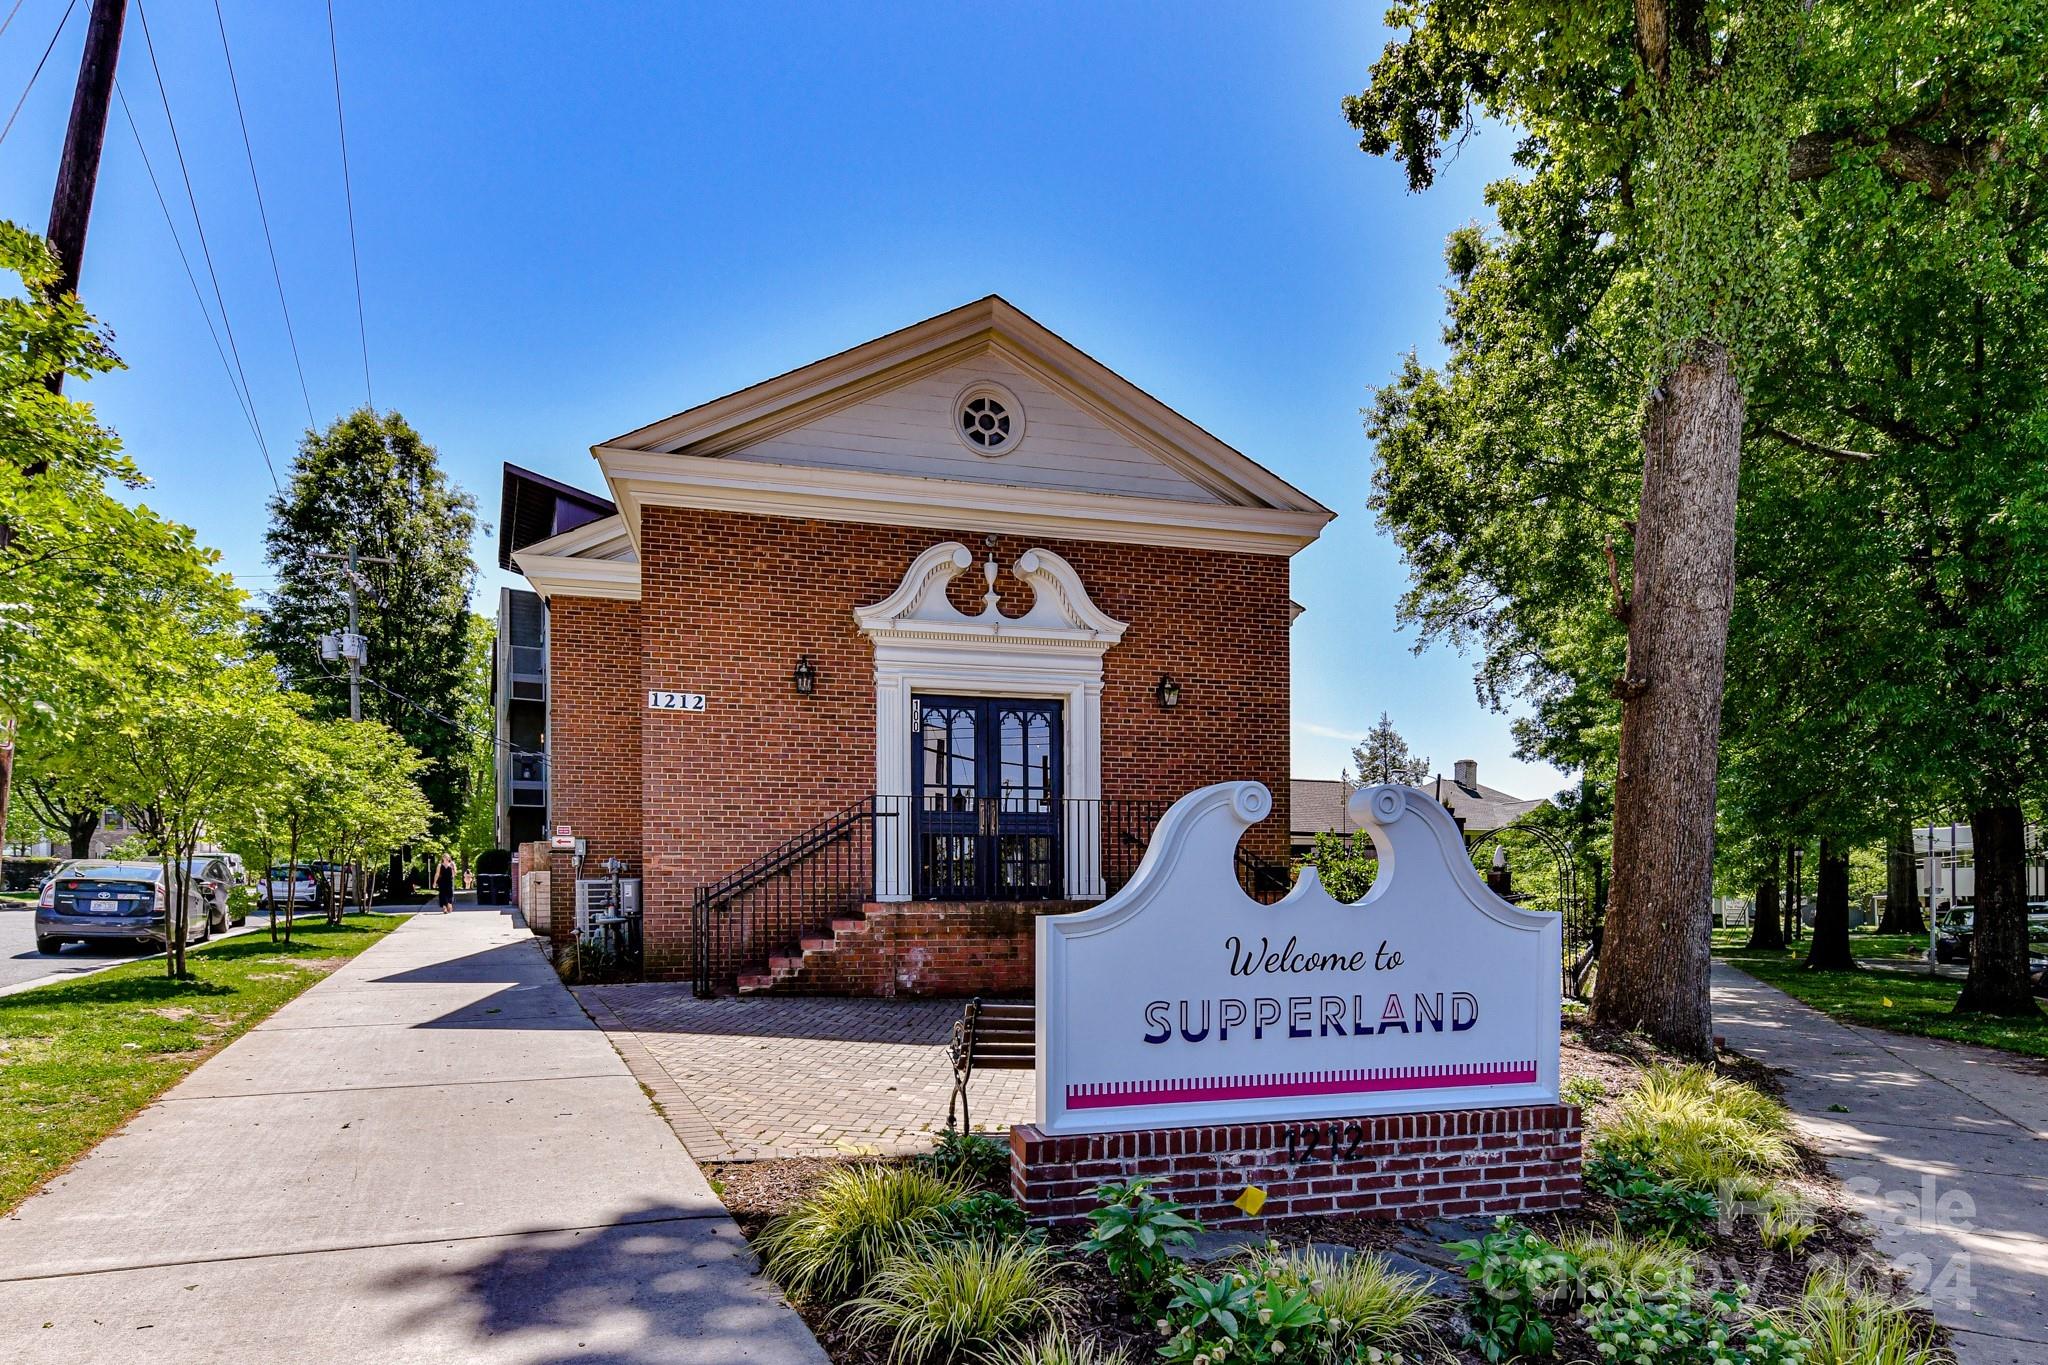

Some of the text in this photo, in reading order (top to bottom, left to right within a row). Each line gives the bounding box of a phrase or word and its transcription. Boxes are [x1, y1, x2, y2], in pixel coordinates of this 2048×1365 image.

[651, 692, 704, 710] 1212
[1225, 935, 1405, 976] Welcome to
[1143, 991, 1479, 1044] SUPPERLAND
[1285, 1123, 1364, 1165] 1212
